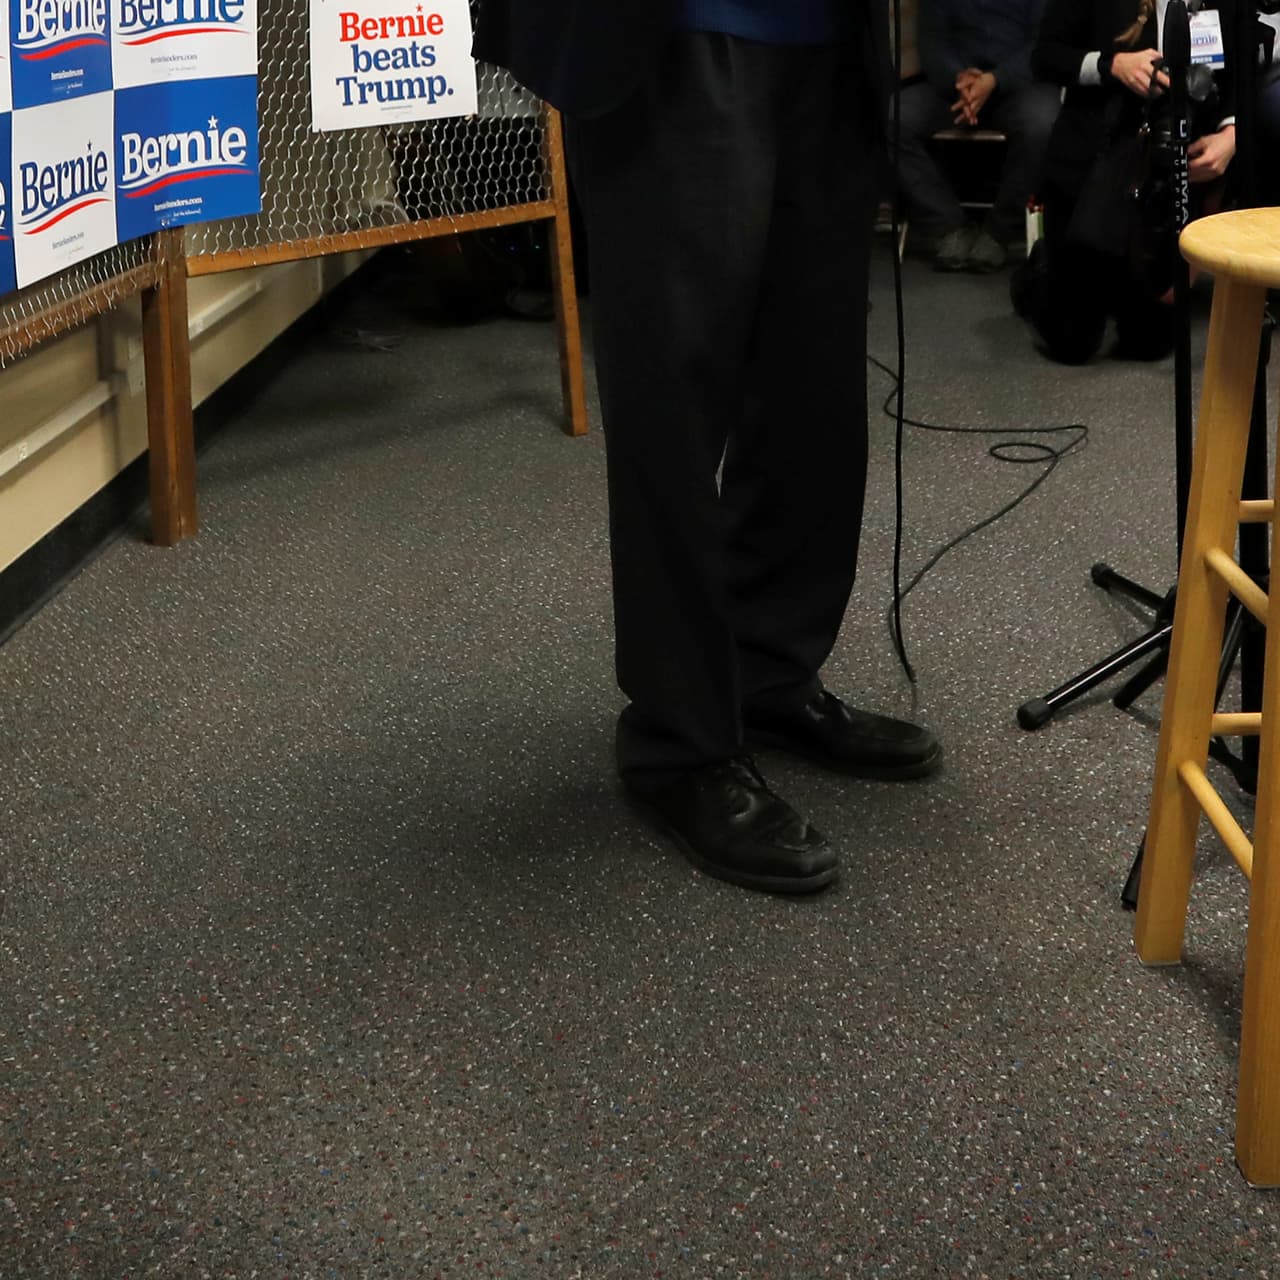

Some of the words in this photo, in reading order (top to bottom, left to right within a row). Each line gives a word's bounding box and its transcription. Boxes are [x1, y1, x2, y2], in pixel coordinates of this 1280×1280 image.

[339, 4, 444, 42] Bernie
[351, 41, 436, 72] beats
[336, 75, 454, 106] Trump.
[122, 115, 247, 181] Bernie
[20, 139, 108, 216] Bernie
